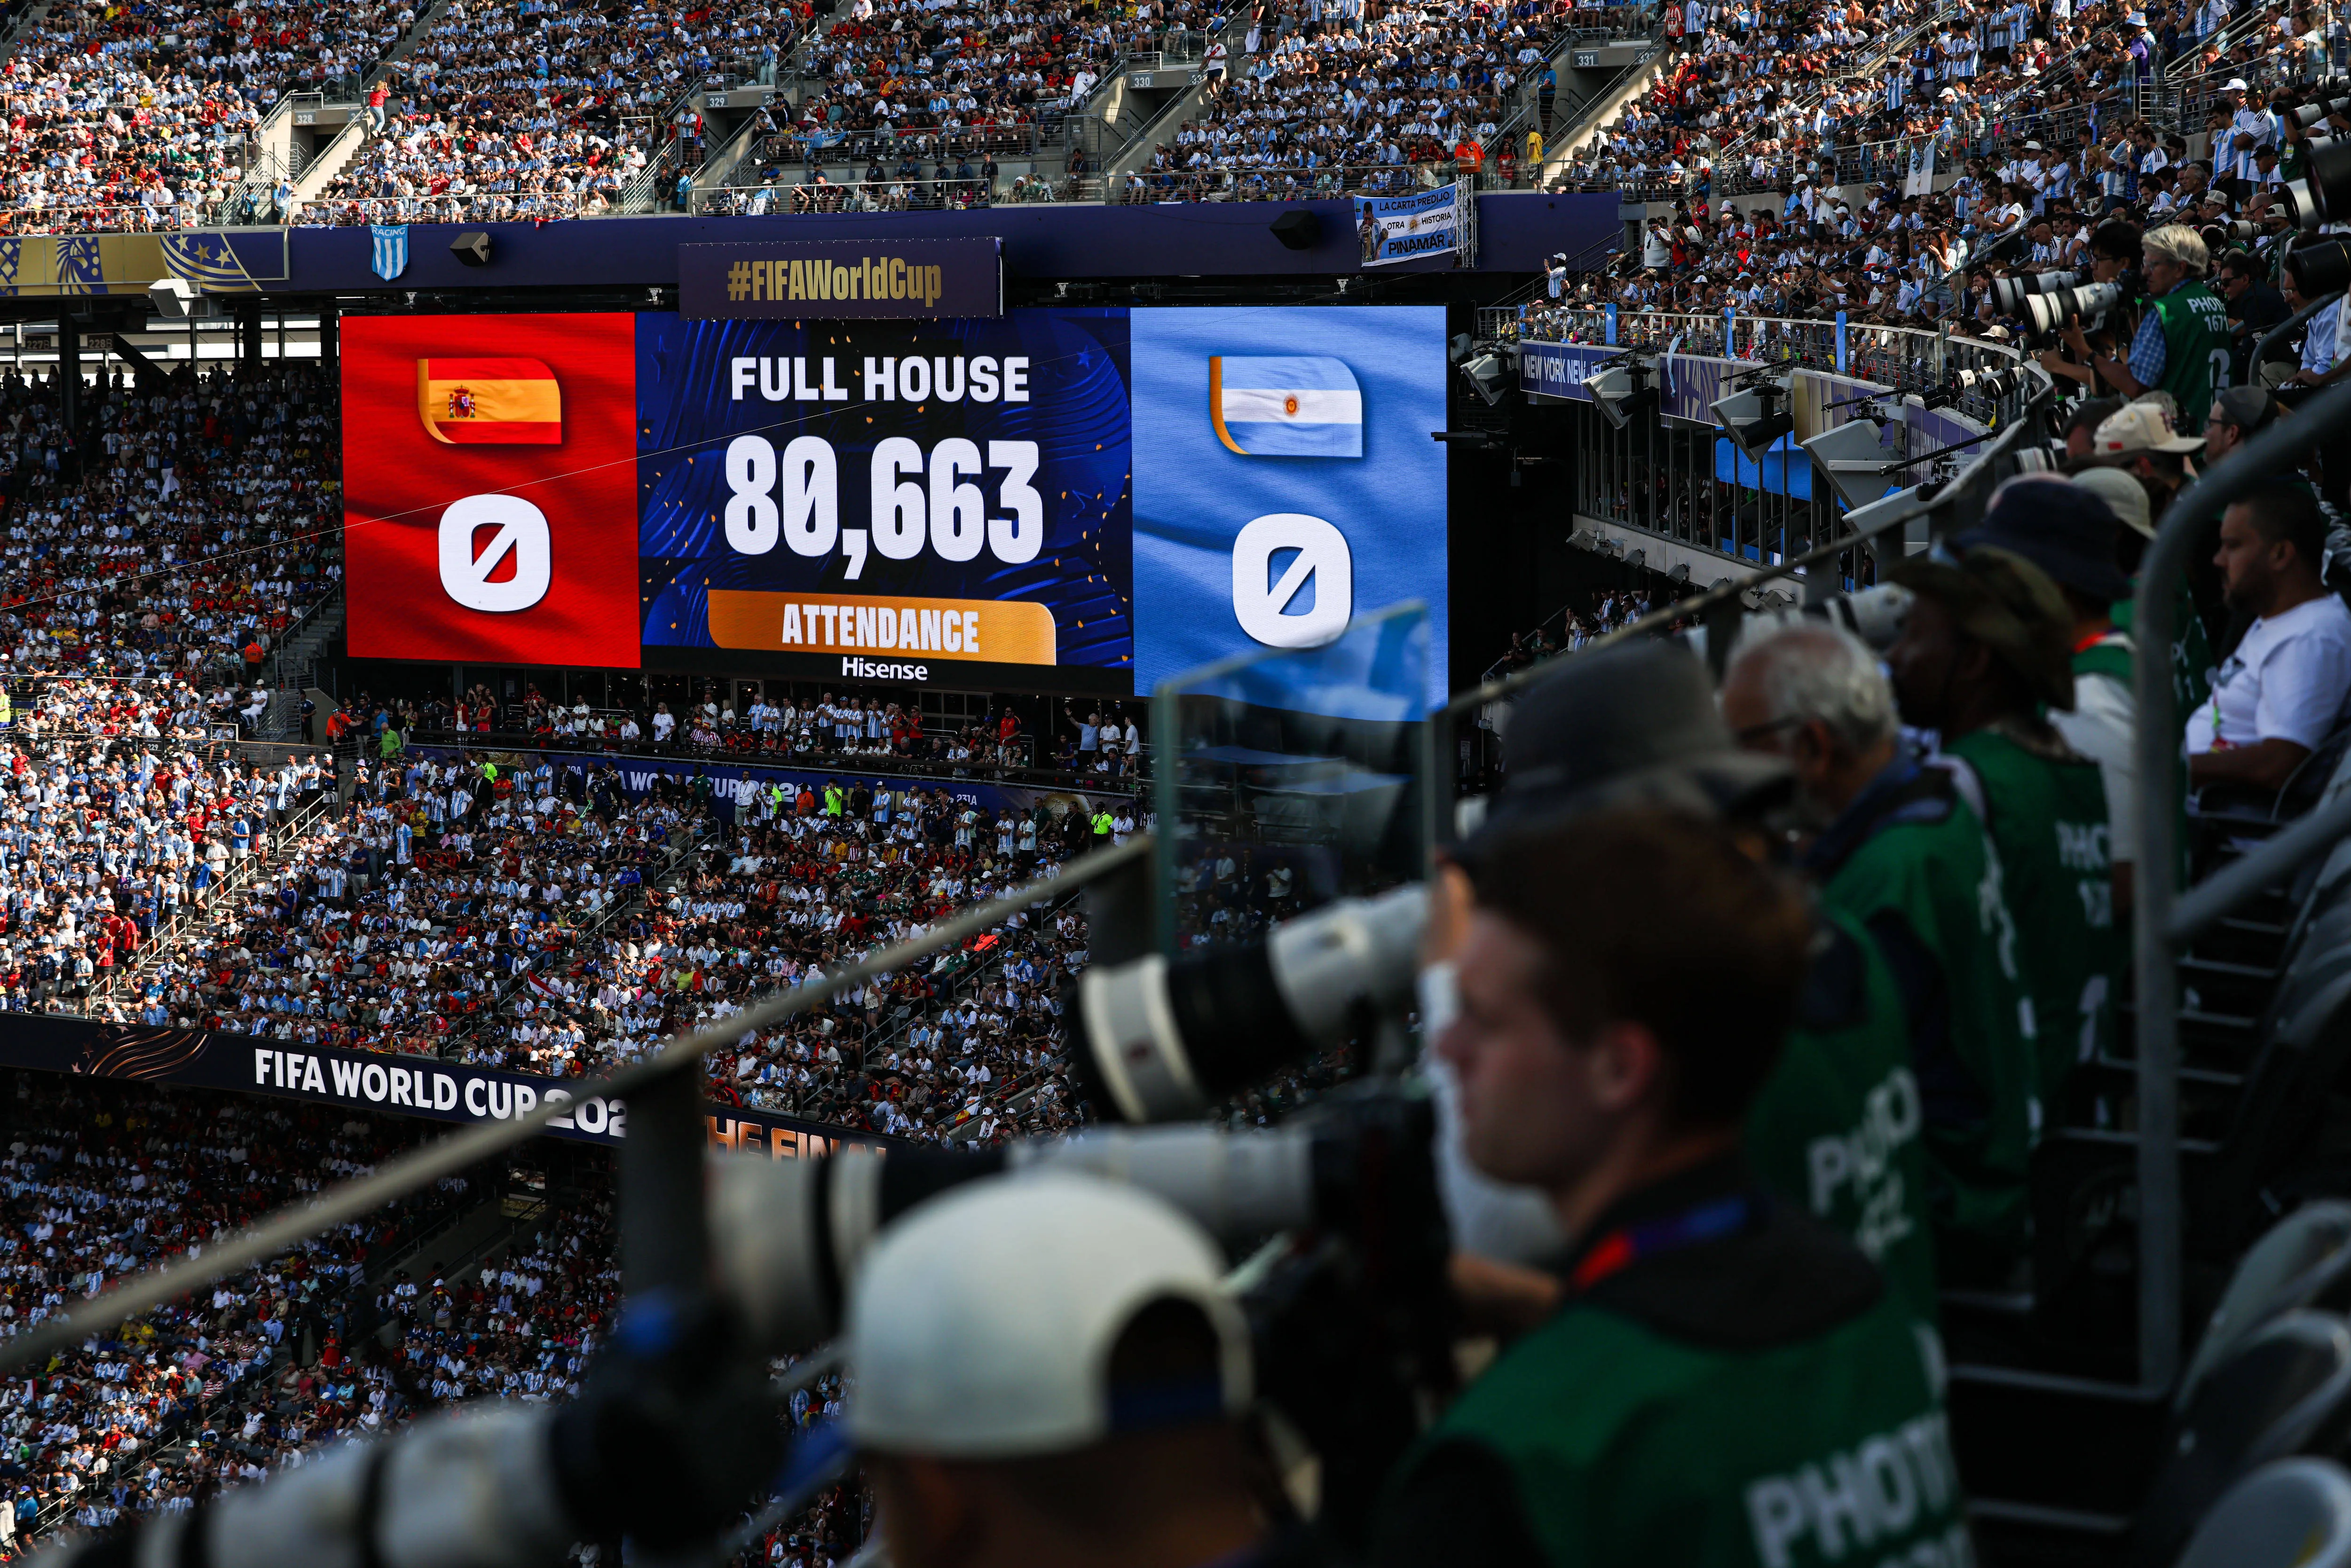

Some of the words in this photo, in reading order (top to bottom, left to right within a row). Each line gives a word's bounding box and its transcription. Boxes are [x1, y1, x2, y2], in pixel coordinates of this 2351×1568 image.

[1578, 55, 1594, 66] 331
[1134, 77, 1150, 87] 330
[710, 97, 725, 107] 329
[297, 114, 313, 123] 328
[1379, 202, 1390, 211] LA
[1391, 200, 1416, 210] CARTA
[1417, 191, 1450, 207] PREDIJO
[371, 226, 406, 236] RACING
[1387, 221, 1404, 230] OTRA
[1421, 212, 1452, 225] HISTORIA
[1388, 234, 1445, 255] PINAMAR
[727, 257, 941, 307] #FIFAWorldCup
[27, 340, 50, 349] 227B
[89, 339, 112, 349] 228B
[731, 356, 848, 401] FULL
[864, 356, 1029, 402] HOUSE
[1524, 354, 1542, 379] NEW
[1544, 356, 1566, 383] YORK
[1567, 359, 1586, 385] NEW
[724, 435, 1043, 580] 80,663
[438, 494, 551, 612] 0
[1232, 513, 1352, 648] 0
[781, 604, 979, 653] ATTENDANCE
[842, 656, 928, 681] Hisense
[957, 794, 977, 806] 231A
[255, 1048, 326, 1094] FIFA
[330, 1059, 458, 1111] WORLD
[465, 1078, 536, 1121] CUP
[544, 1088, 627, 1138] 202
